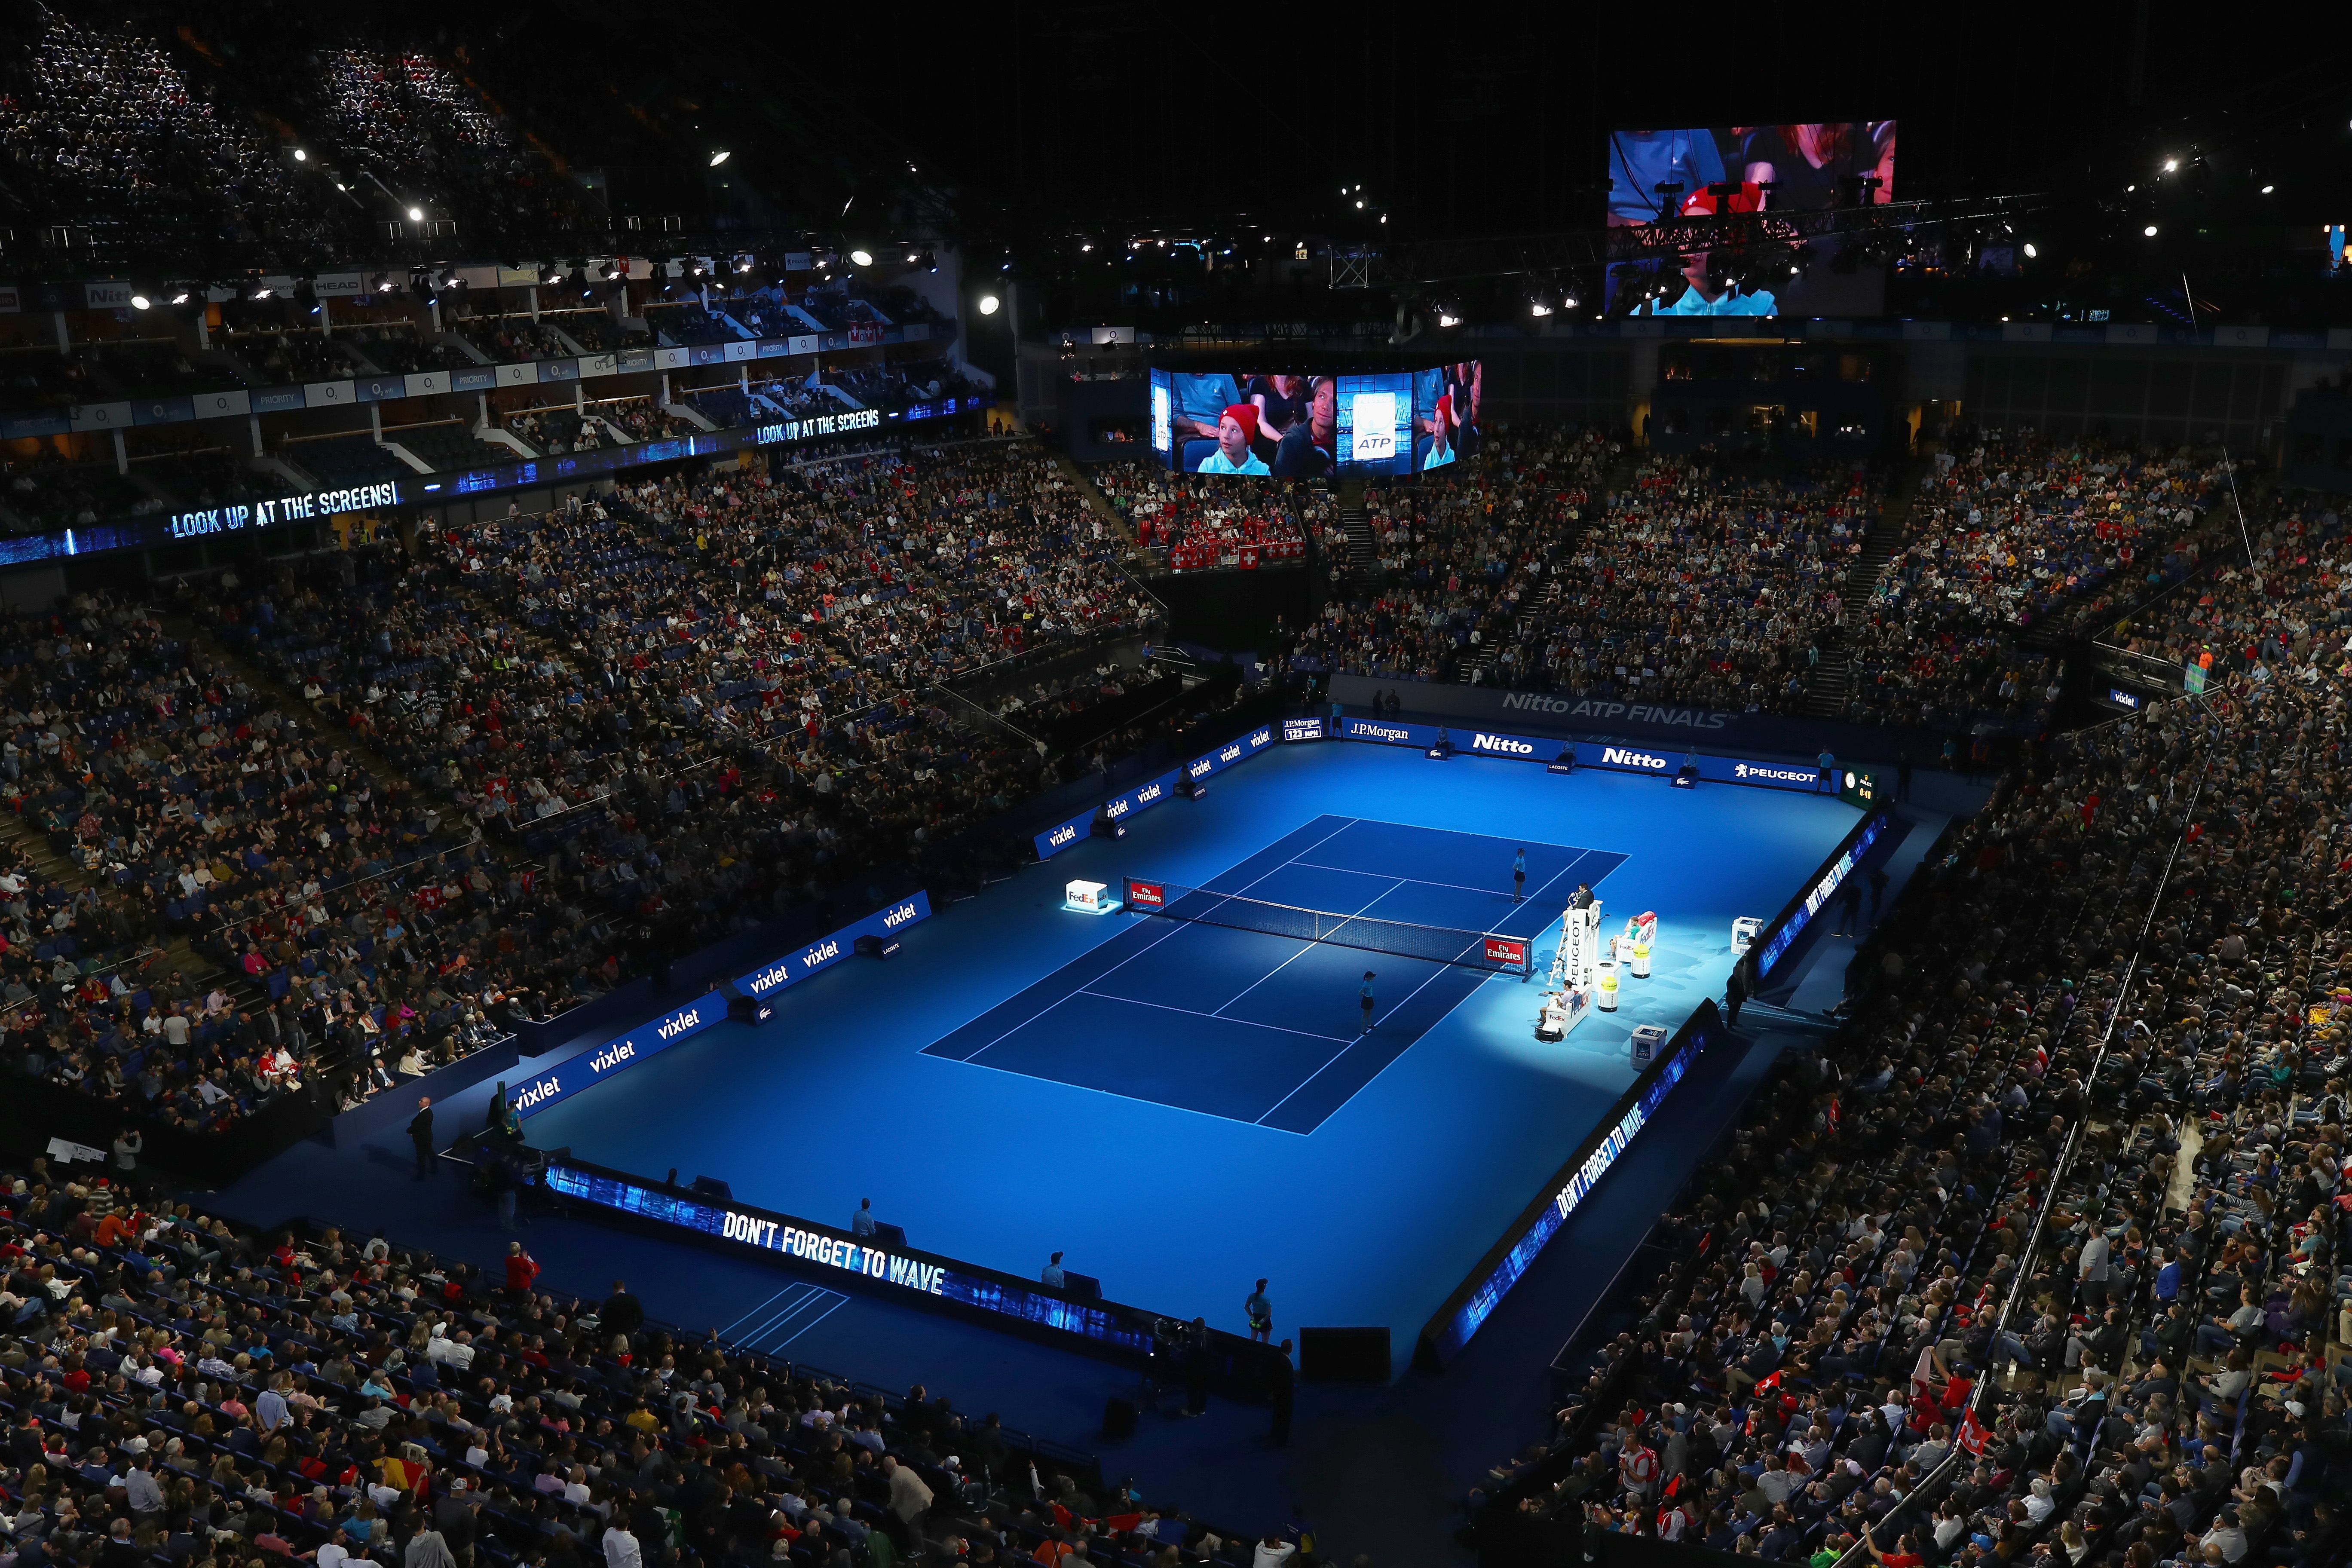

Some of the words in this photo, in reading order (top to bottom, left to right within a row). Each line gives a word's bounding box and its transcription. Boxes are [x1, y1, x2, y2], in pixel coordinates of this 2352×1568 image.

[316, 282, 358, 291] HEAD
[90, 289, 131, 303] Nitt
[763, 344, 783, 352] PRIORITY
[459, 375, 487, 385] PRIORITY
[260, 394, 294, 405] PRIORITY
[757, 424, 784, 444] LOOK
[786, 421, 799, 440] UP
[802, 419, 814, 437] AT
[816, 416, 836, 435] THE
[837, 409, 879, 432] SCREENS
[1158, 430, 1166, 441] ATP
[1358, 438, 1391, 450] ATP
[172, 508, 222, 539] LOOK
[225, 505, 248, 530] UP
[256, 500, 277, 527] AT
[280, 492, 315, 521] THE
[1502, 693, 1569, 713] Nitto
[1571, 700, 1625, 718] ATP
[2115, 692, 2135, 708] vixlet
[1284, 719, 1320, 728] J.P.Morgan
[1351, 723, 1409, 741] J.P.Morgan
[1250, 730, 1270, 748] vixlet
[1288, 729, 1303, 738] 123
[1473, 734, 1533, 754] Nitto
[1220, 744, 1241, 763] vixlet
[1602, 747, 1666, 768] Nitto
[1190, 759, 1212, 778] vixlet
[1749, 768, 1816, 782] PEUGEOT
[1860, 778, 1872, 787] ROLEX
[1137, 784, 1161, 804] vixlet
[1049, 825, 1076, 847] vixlet
[1805, 888, 1822, 917] DON'T
[1818, 869, 1838, 902] FORGET
[1833, 864, 1843, 883] TO
[1838, 851, 1854, 877] WAVE
[1069, 891, 1095, 904] FedEx
[1132, 891, 1161, 903] Emirates
[883, 903, 916, 928] vixlet
[1640, 925, 1655, 944] FedEx
[802, 940, 839, 968] vixlet
[883, 943, 900, 955] LACOSTE
[1487, 948, 1521, 961] Emirates
[1498, 944, 1509, 953] Fly
[1571, 918, 1580, 986] PEUGEOT
[750, 965, 789, 994] vixlet
[657, 1008, 700, 1040] vixlet
[1550, 1014, 1565, 1022] FedEx
[589, 1040, 635, 1073] vixlet
[515, 1076, 561, 1112] vixlet
[1556, 1172, 1584, 1220] DON'T
[1580, 1137, 1614, 1191] FORGET
[1610, 1126, 1626, 1154] TO
[1620, 1101, 1645, 1142] WAVE
[722, 1211, 778, 1249] DON'T
[781, 1225, 857, 1270] FORGET
[861, 1246, 886, 1278] TO
[888, 1254, 945, 1295] WAVE
